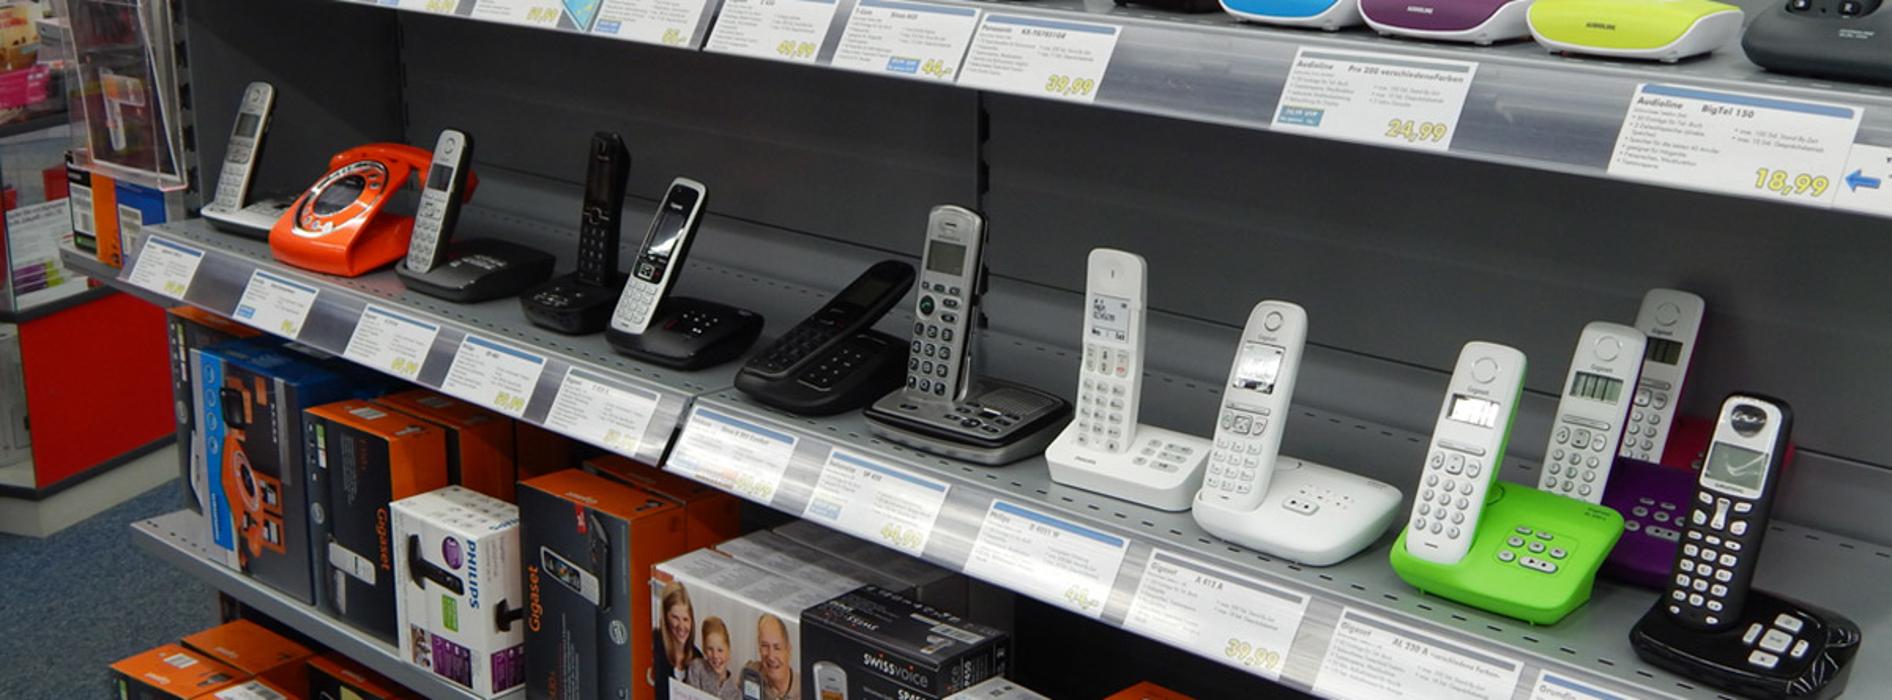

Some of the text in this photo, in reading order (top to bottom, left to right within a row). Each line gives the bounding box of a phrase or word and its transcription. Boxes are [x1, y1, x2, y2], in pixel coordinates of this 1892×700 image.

[1044, 74, 1096, 97] 39,99
[1637, 96, 1684, 111] Audioline
[1701, 104, 1733, 117] BigTel
[1384, 118, 1448, 143] 24,99
[1754, 166, 1830, 198] 18,99
[467, 539, 480, 609] PHILIPS
[528, 564, 544, 633] Gigaset
[1224, 636, 1281, 671] 39,99
